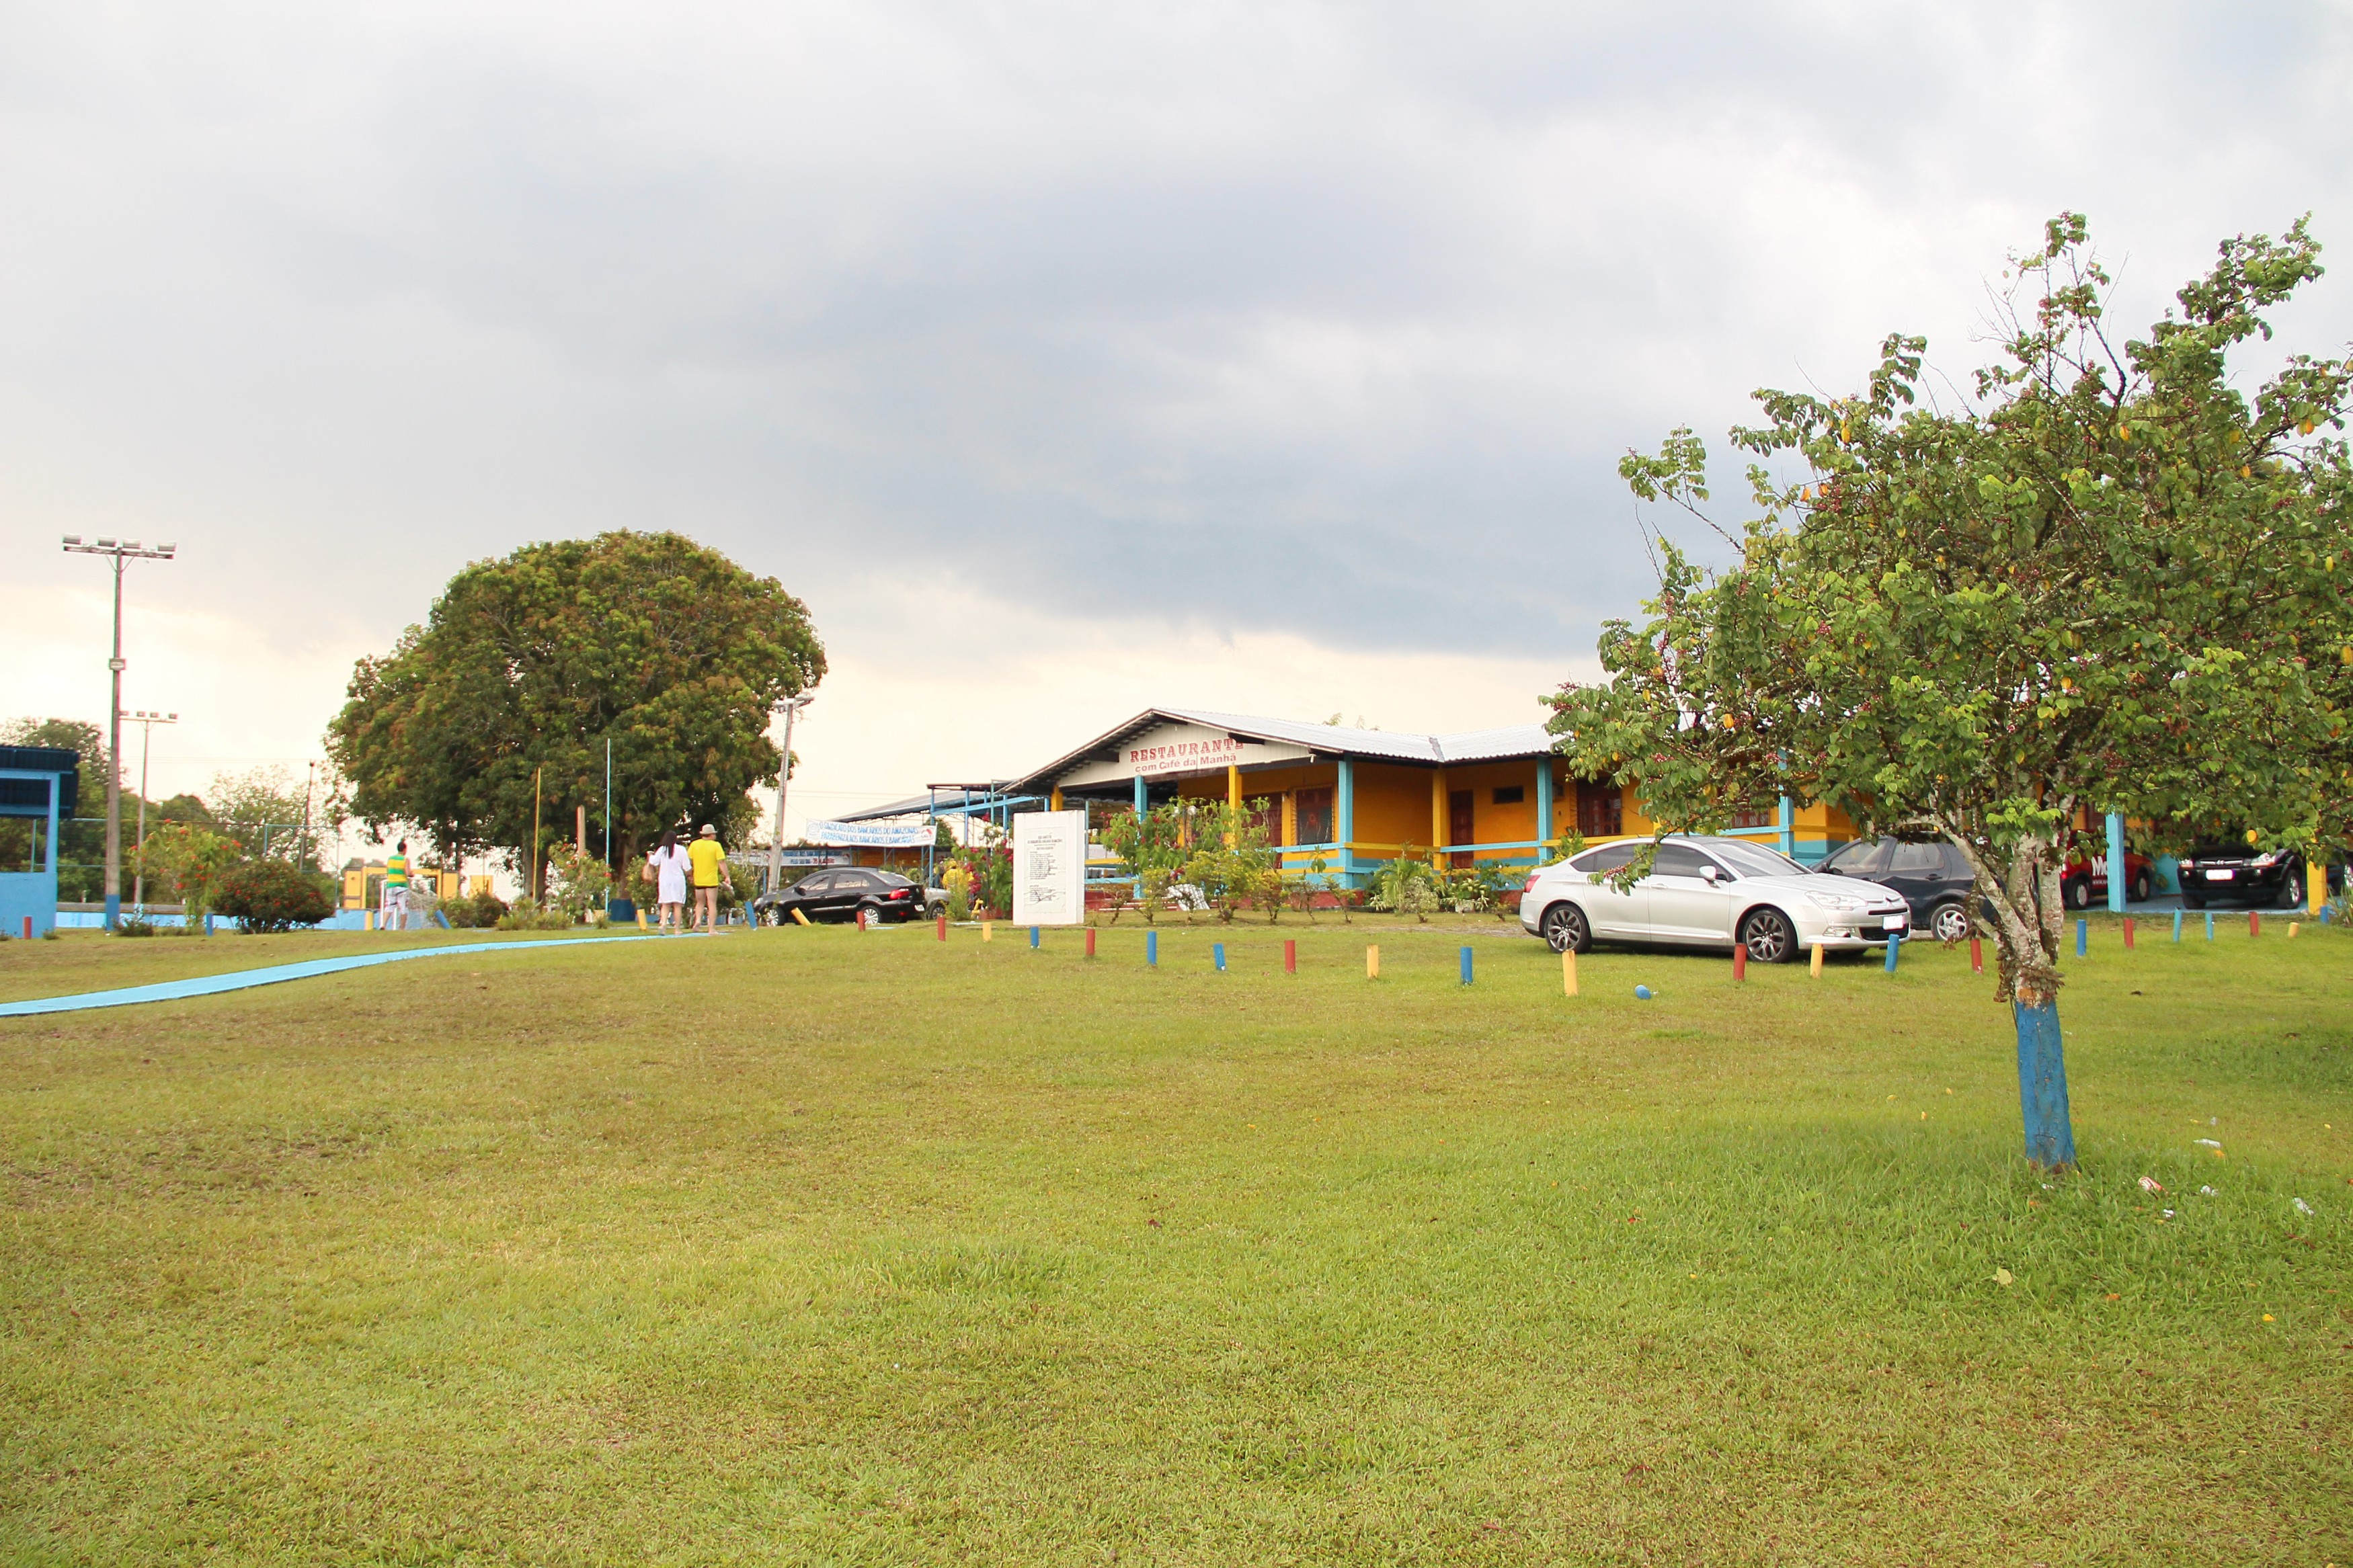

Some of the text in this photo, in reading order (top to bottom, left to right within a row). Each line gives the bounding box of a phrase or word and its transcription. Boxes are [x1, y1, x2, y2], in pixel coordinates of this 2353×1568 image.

[1130, 738, 1244, 763] RESTAURANTE
[1135, 752, 1236, 772] com Café da Manhã
[824, 822, 846, 831] SINDICATO
